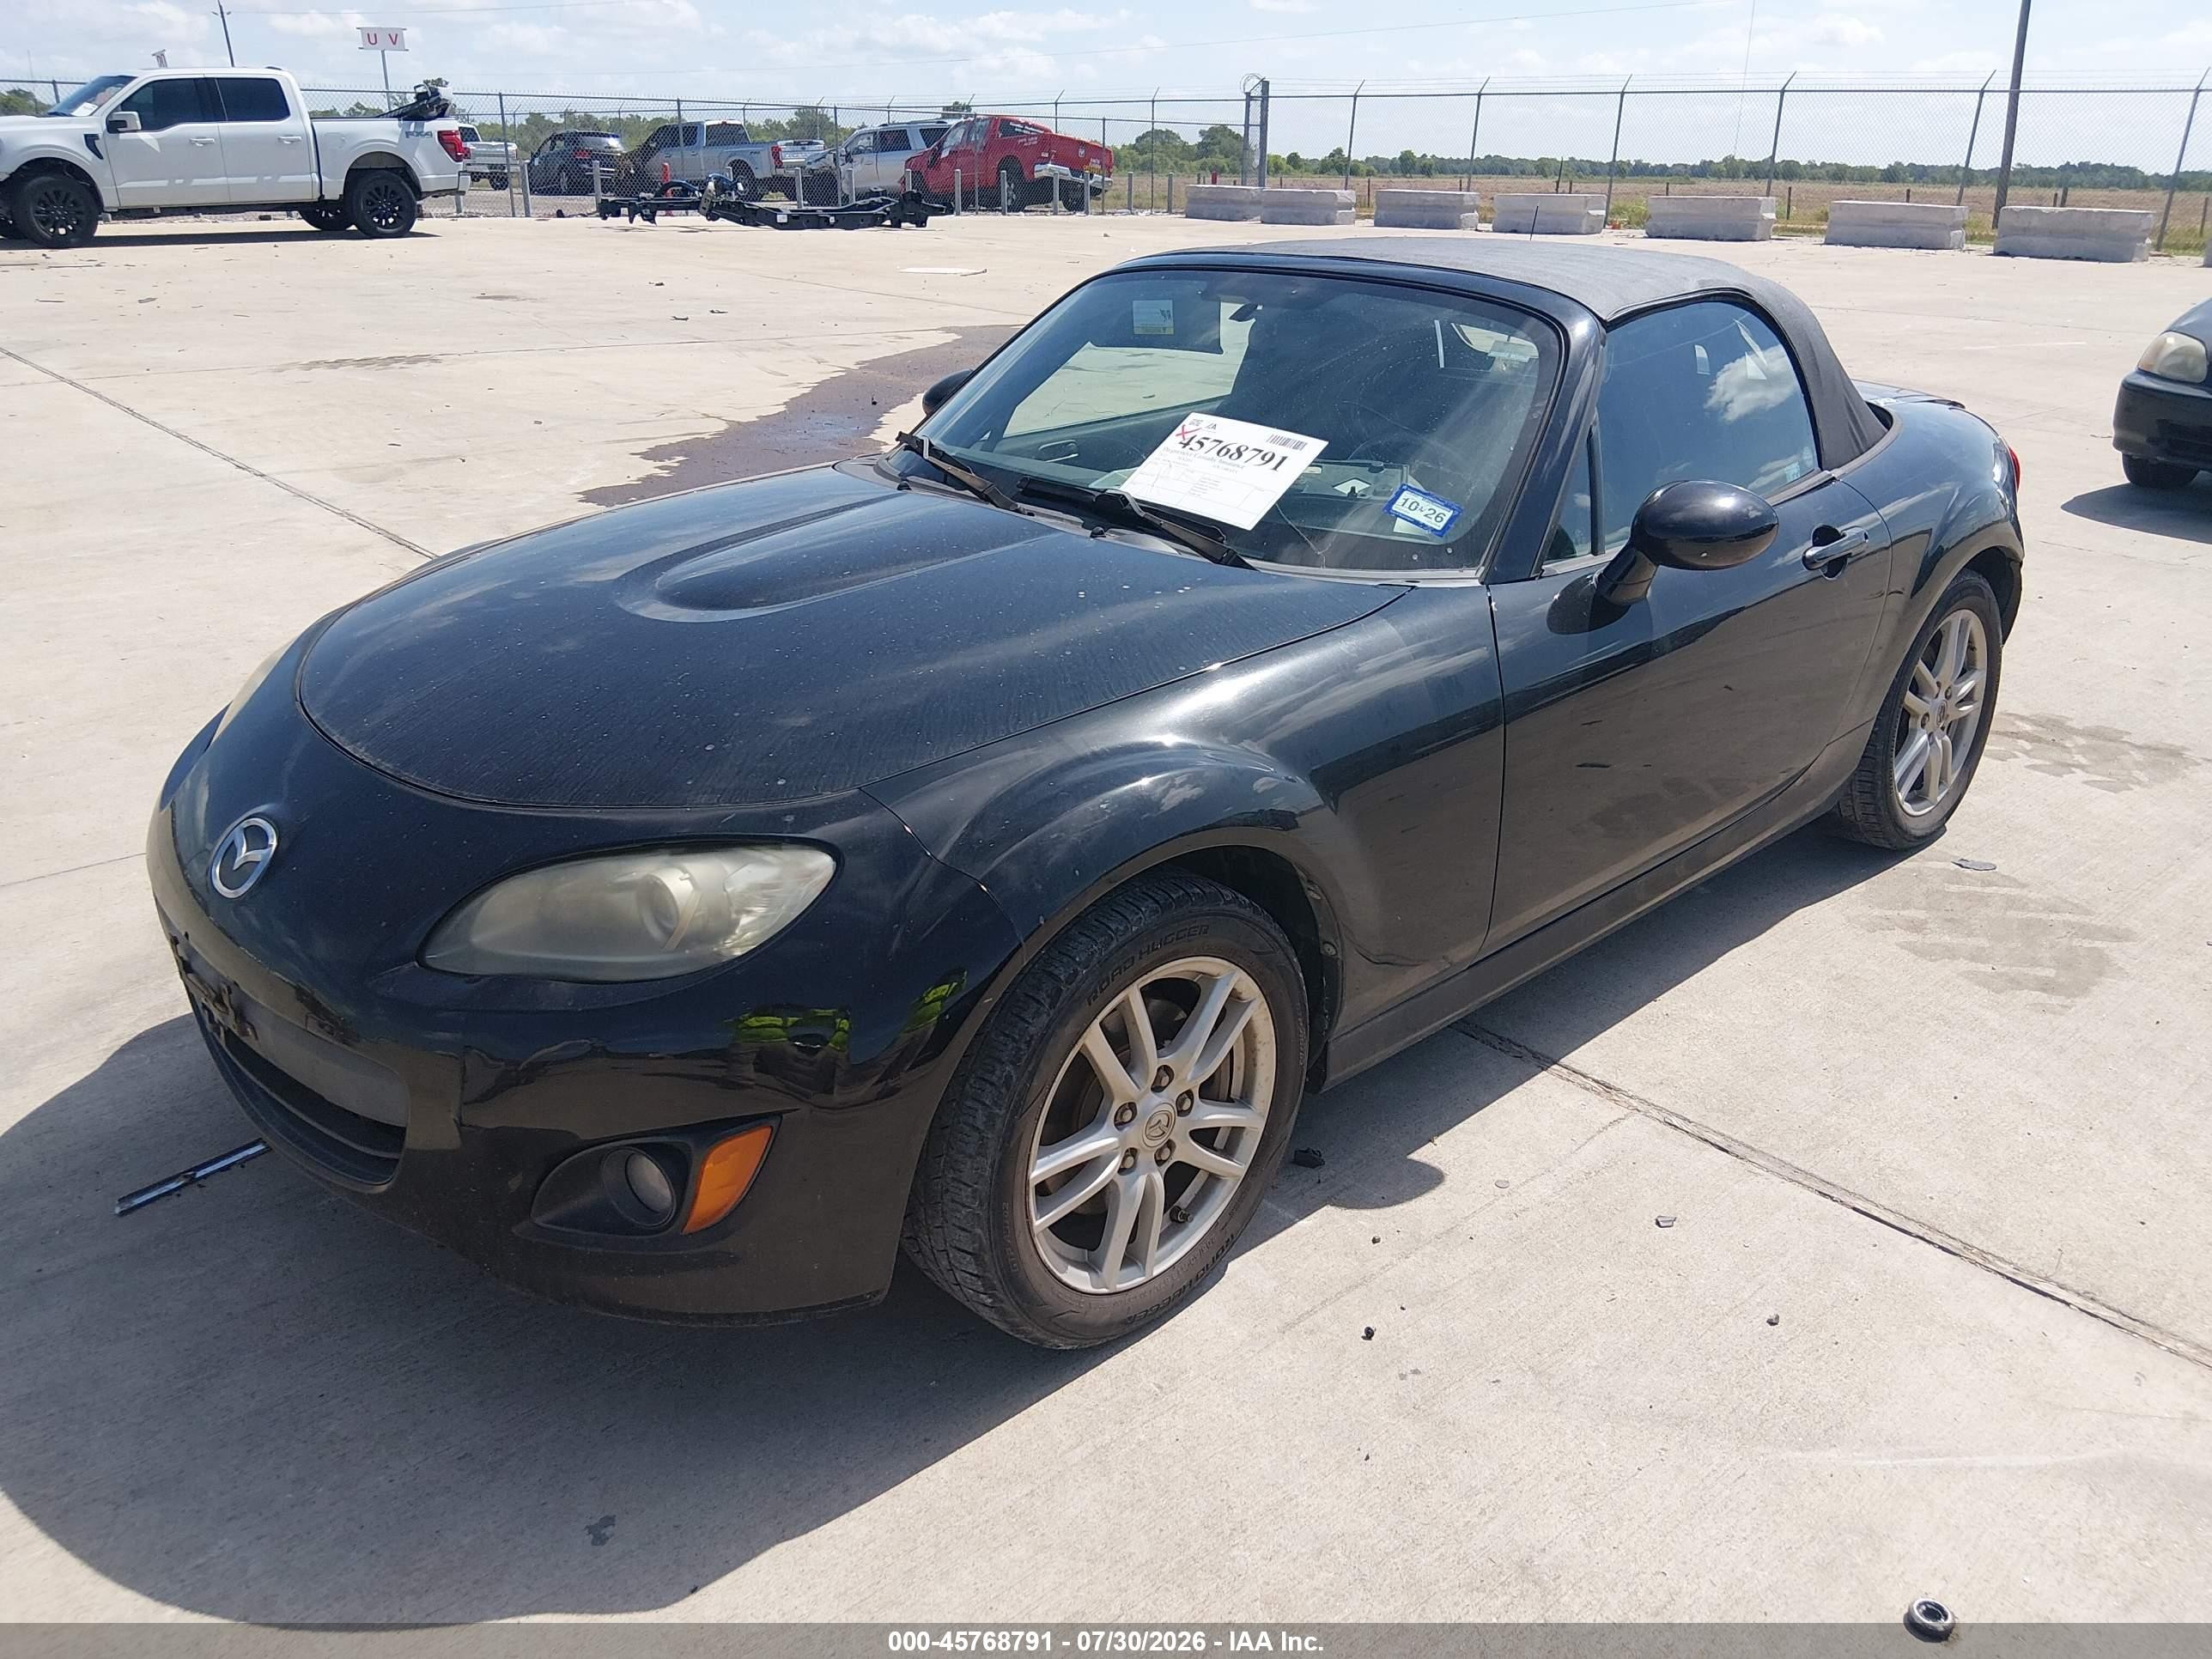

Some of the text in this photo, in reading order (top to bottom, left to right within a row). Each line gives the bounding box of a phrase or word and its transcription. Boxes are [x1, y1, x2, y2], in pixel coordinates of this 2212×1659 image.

[367, 33, 398, 46] U V
[1178, 434, 1290, 472] 45768791
[1401, 496, 1420, 512] 10
[1424, 507, 1446, 524] 26
[1085, 924, 1210, 1006] ROAD HUGGER
